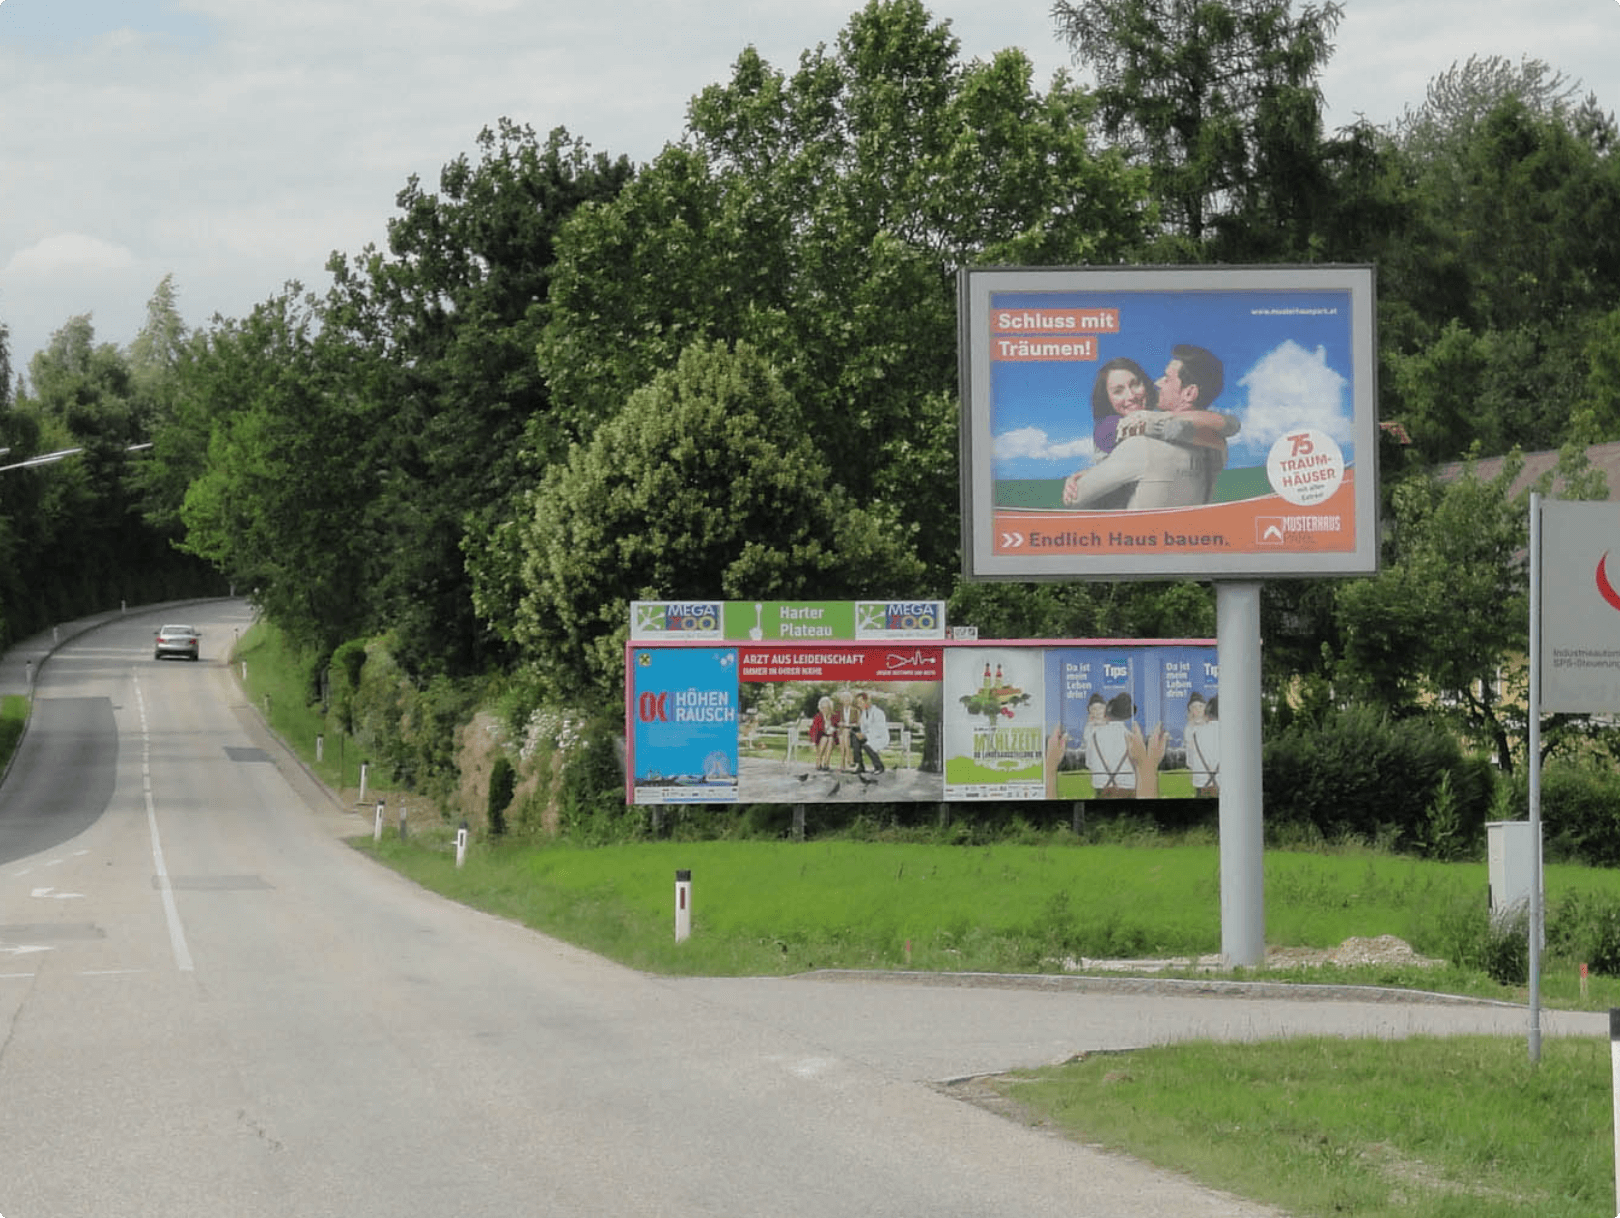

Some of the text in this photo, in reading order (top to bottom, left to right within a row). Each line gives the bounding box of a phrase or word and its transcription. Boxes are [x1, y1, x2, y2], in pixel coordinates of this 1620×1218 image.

[999, 312, 1114, 329] Schluss mit
[999, 340, 1091, 356] Träumen!
[1287, 433, 1314, 457] 75
[1280, 454, 1332, 471] TRAUM-
[1282, 468, 1336, 487] HÄUSER
[1029, 532, 1229, 547] Endlich Haus bauen.
[667, 604, 716, 616] MEGA
[780, 606, 824, 619] Harter
[888, 604, 935, 615] MEGA
[668, 616, 716, 631] ZOO
[780, 623, 833, 637] Plateau
[889, 615, 935, 630] ZOO
[743, 654, 864, 665] ARZT AUS LEIDENSCHAFT
[1103, 664, 1127, 680] Tips
[1204, 663, 1218, 679] Tip
[1067, 680, 1092, 690] Leben
[1166, 680, 1192, 689] Leben
[676, 687, 728, 706] HÖHEN
[676, 706, 735, 722] RAUSCH
